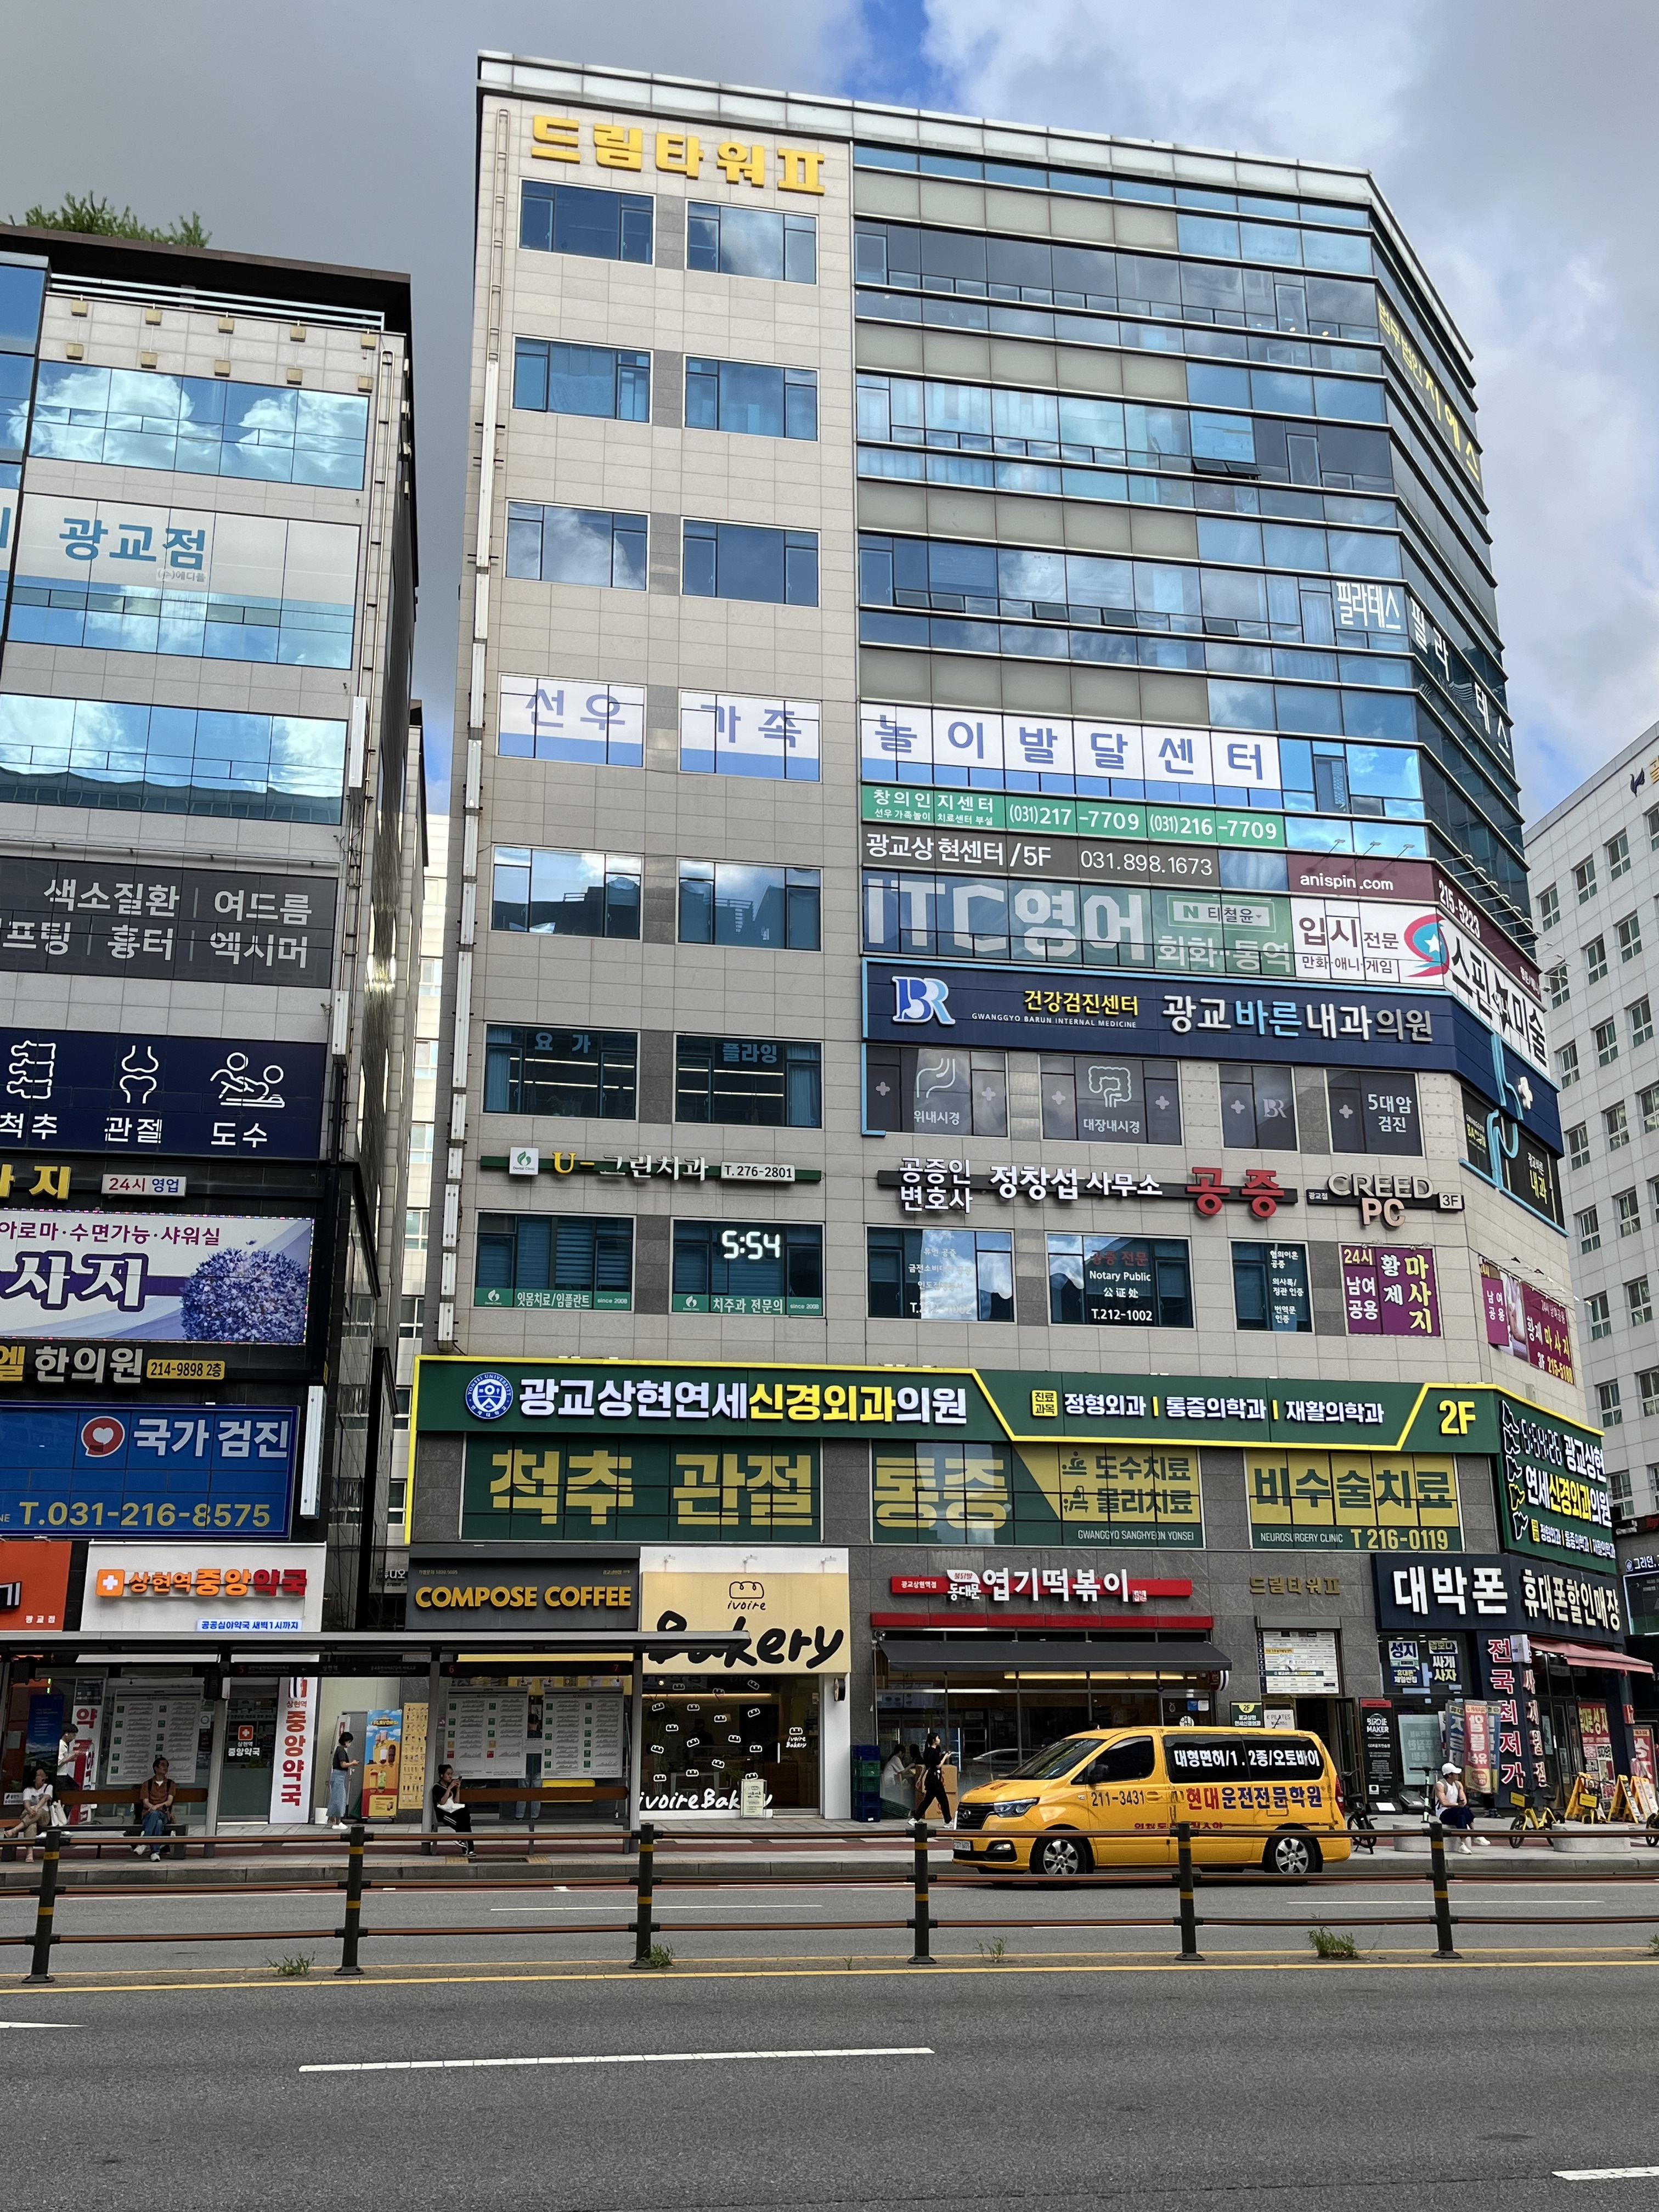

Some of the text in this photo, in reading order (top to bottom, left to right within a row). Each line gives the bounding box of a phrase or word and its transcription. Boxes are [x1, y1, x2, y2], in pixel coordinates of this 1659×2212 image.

[59, 517, 206, 571] 광교점
[1336, 582, 1401, 629] 필라테스
[1410, 597, 1511, 759] 필라테스
[526, 689, 625, 730] 선우
[701, 704, 802, 748] 가족
[874, 809, 892, 819] 선우
[1009, 803, 1139, 831] (031)217-7709
[1150, 813, 1277, 839] (031)216-7709
[1081, 849, 1212, 876] 031.898.1673
[44, 878, 312, 926] 색소질환 여드름
[1438, 879, 1480, 939] 215-5223
[0, 918, 308, 968] 프팅 흉터 엑시머
[1299, 916, 1400, 950] 입시 전문
[1024, 990, 1139, 1017] 건강검진센터
[972, 1013, 1136, 1029] GWANGGYO BARUN INTERNAL MEDICINE
[722, 1042, 777, 1064] 플라잉
[1368, 1093, 1412, 1114] 5대암
[0, 1113, 58, 1140] 척추
[211, 1121, 268, 1148] 도수
[913, 1110, 960, 1125] 위내시경
[1083, 1118, 1141, 1135] 대장내시경
[1378, 1116, 1407, 1133] 검진
[899, 1157, 971, 1184] 공증인
[990, 1165, 1163, 1200] 정창섭 사무소
[108, 1177, 180, 1193] 24시 영업
[1187, 1167, 1285, 1217] 공증
[1308, 1172, 1458, 1206] 광교점 CREED 3F
[900, 1186, 973, 1214] 변호사
[1362, 1199, 1406, 1227] PC
[722, 1231, 780, 1260] 5:54
[1344, 1249, 1373, 1265] 24시
[1123, 1251, 1149, 1267] 전문
[1090, 1270, 1151, 1282] Notary Public
[1346, 1276, 1375, 1297] 남여
[517, 1291, 590, 1308] 잇몸치료/임플란트
[1273, 1287, 1304, 1296] 정관 인증
[1380, 1255, 1432, 1334] 황제 마사지
[712, 1297, 746, 1313] 치주과
[750, 1299, 783, 1314] 전문의
[1091, 1308, 1152, 1321] T.212-1002
[1274, 1306, 1296, 1314] 번역문
[1347, 1300, 1378, 1321] 공용
[1544, 1325, 1570, 1362] 마사지
[35, 1347, 143, 1384] 한의원
[150, 1361, 204, 1378] 214-9898
[206, 1363, 222, 1378] 2층
[1537, 1352, 1545, 1370] 3F
[1034, 1391, 1055, 1403] 진료
[1034, 1403, 1055, 1415] 과목
[1064, 1393, 1385, 1424] 정형외과 통증의학과 재활의학과
[1439, 1401, 1476, 1435] 2F
[133, 1418, 289, 1459] 국가 검진
[1095, 1455, 1190, 1481] 도수치료
[1564, 1434, 1606, 1483] 광교상현
[490, 1449, 812, 1527] 척추 관절
[873, 1457, 1008, 1528] 통증
[1097, 1487, 1193, 1515] 물리치료
[1253, 1467, 1453, 1510] 비수술치료
[1526, 1465, 1612, 1527] 연세신경외과의원
[20, 1501, 270, 1527] T.031-216-8575
[1078, 1530, 1194, 1541] GWANGGYO SANGHYEON YONSEI
[1261, 1532, 1318, 1542] NEUROSURGERY
[1320, 1533, 1343, 1543] CLINIC
[415, 1586, 632, 1608] COMPOSE COFFEE
[947, 1583, 981, 1601] 동대문
[982, 1567, 1129, 1602] 엽기떡볶이
[727, 1601, 766, 1611] ivoire
[1393, 1566, 1620, 1632] 대박폰 휴대폰할인매장
[201, 1620, 250, 1630] 공공심야약국
[1391, 1642, 1417, 1657] 성지
[1432, 1656, 1455, 1668] 싸게
[1434, 1669, 1457, 1681] 사자
[286, 1700, 307, 1708] 상현역
[228, 1747, 261, 1757] 중앙약국
[281, 1709, 307, 1807] 중앙약국
[1091, 1789, 1145, 1808] 211-3431
[1186, 1786, 1322, 1810] 현대운전전문학원
